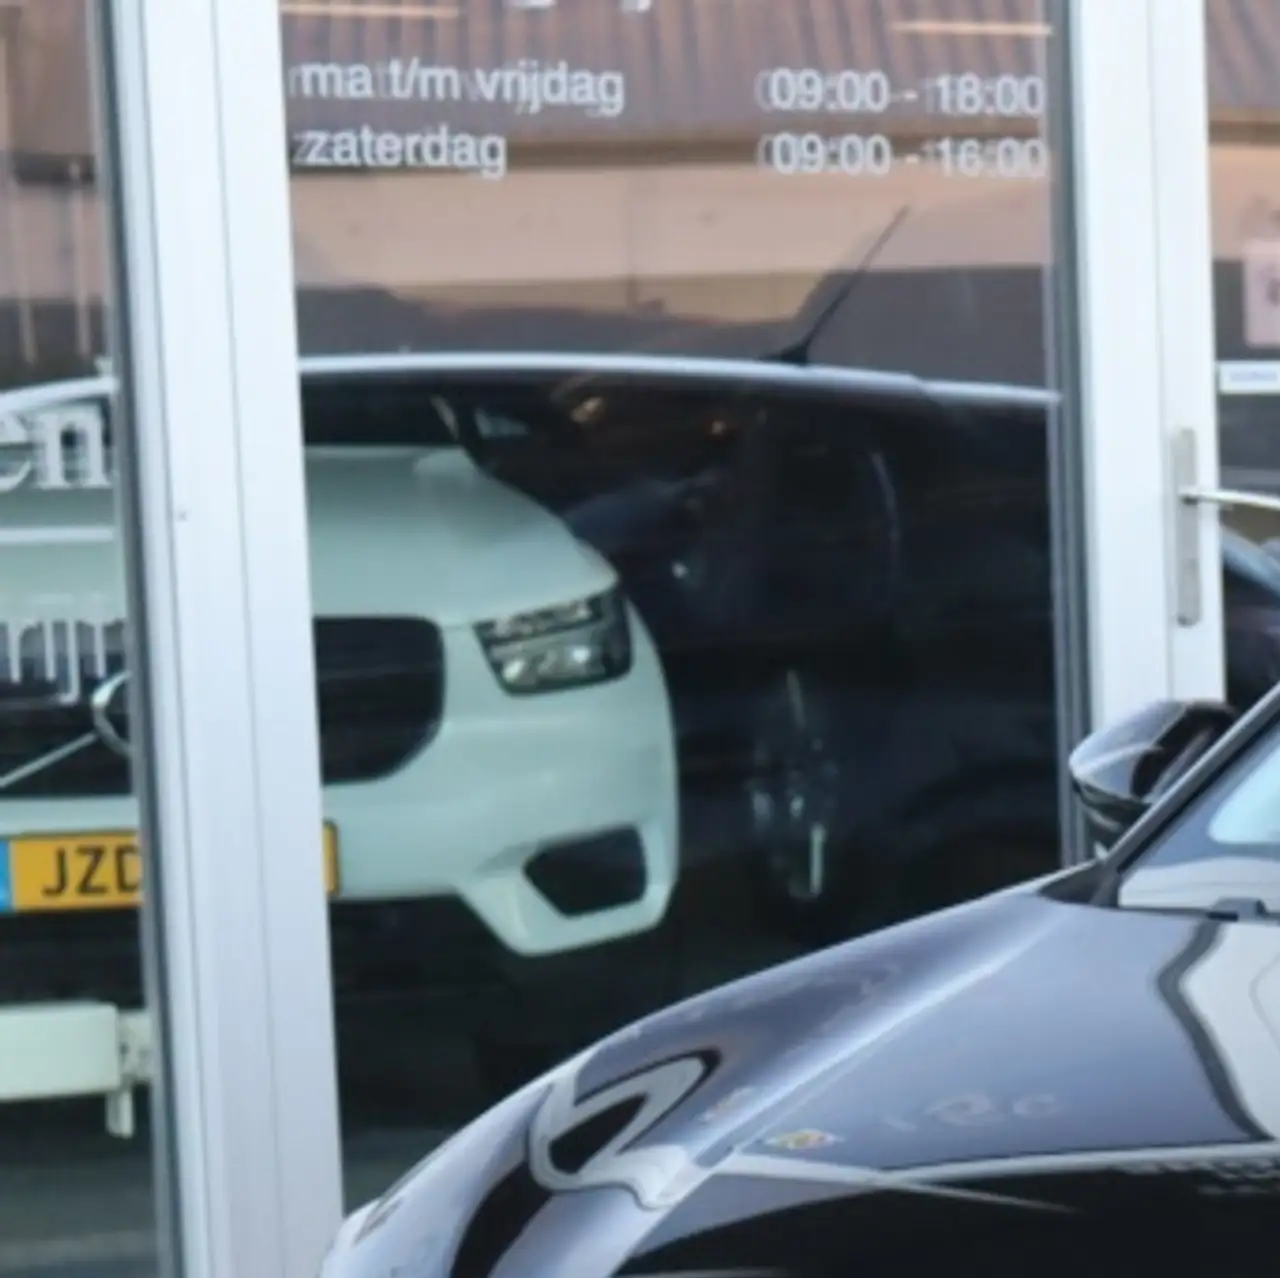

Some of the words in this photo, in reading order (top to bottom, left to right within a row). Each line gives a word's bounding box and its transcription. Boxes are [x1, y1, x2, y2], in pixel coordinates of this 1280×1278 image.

[300, 61, 374, 98] ma
[389, 56, 461, 102] t/m
[475, 58, 625, 117] vrijdag
[768, 67, 890, 113] 09:00
[938, 71, 1045, 117] 18:00
[303, 123, 507, 180] zaterdag
[769, 132, 891, 176] 09:00
